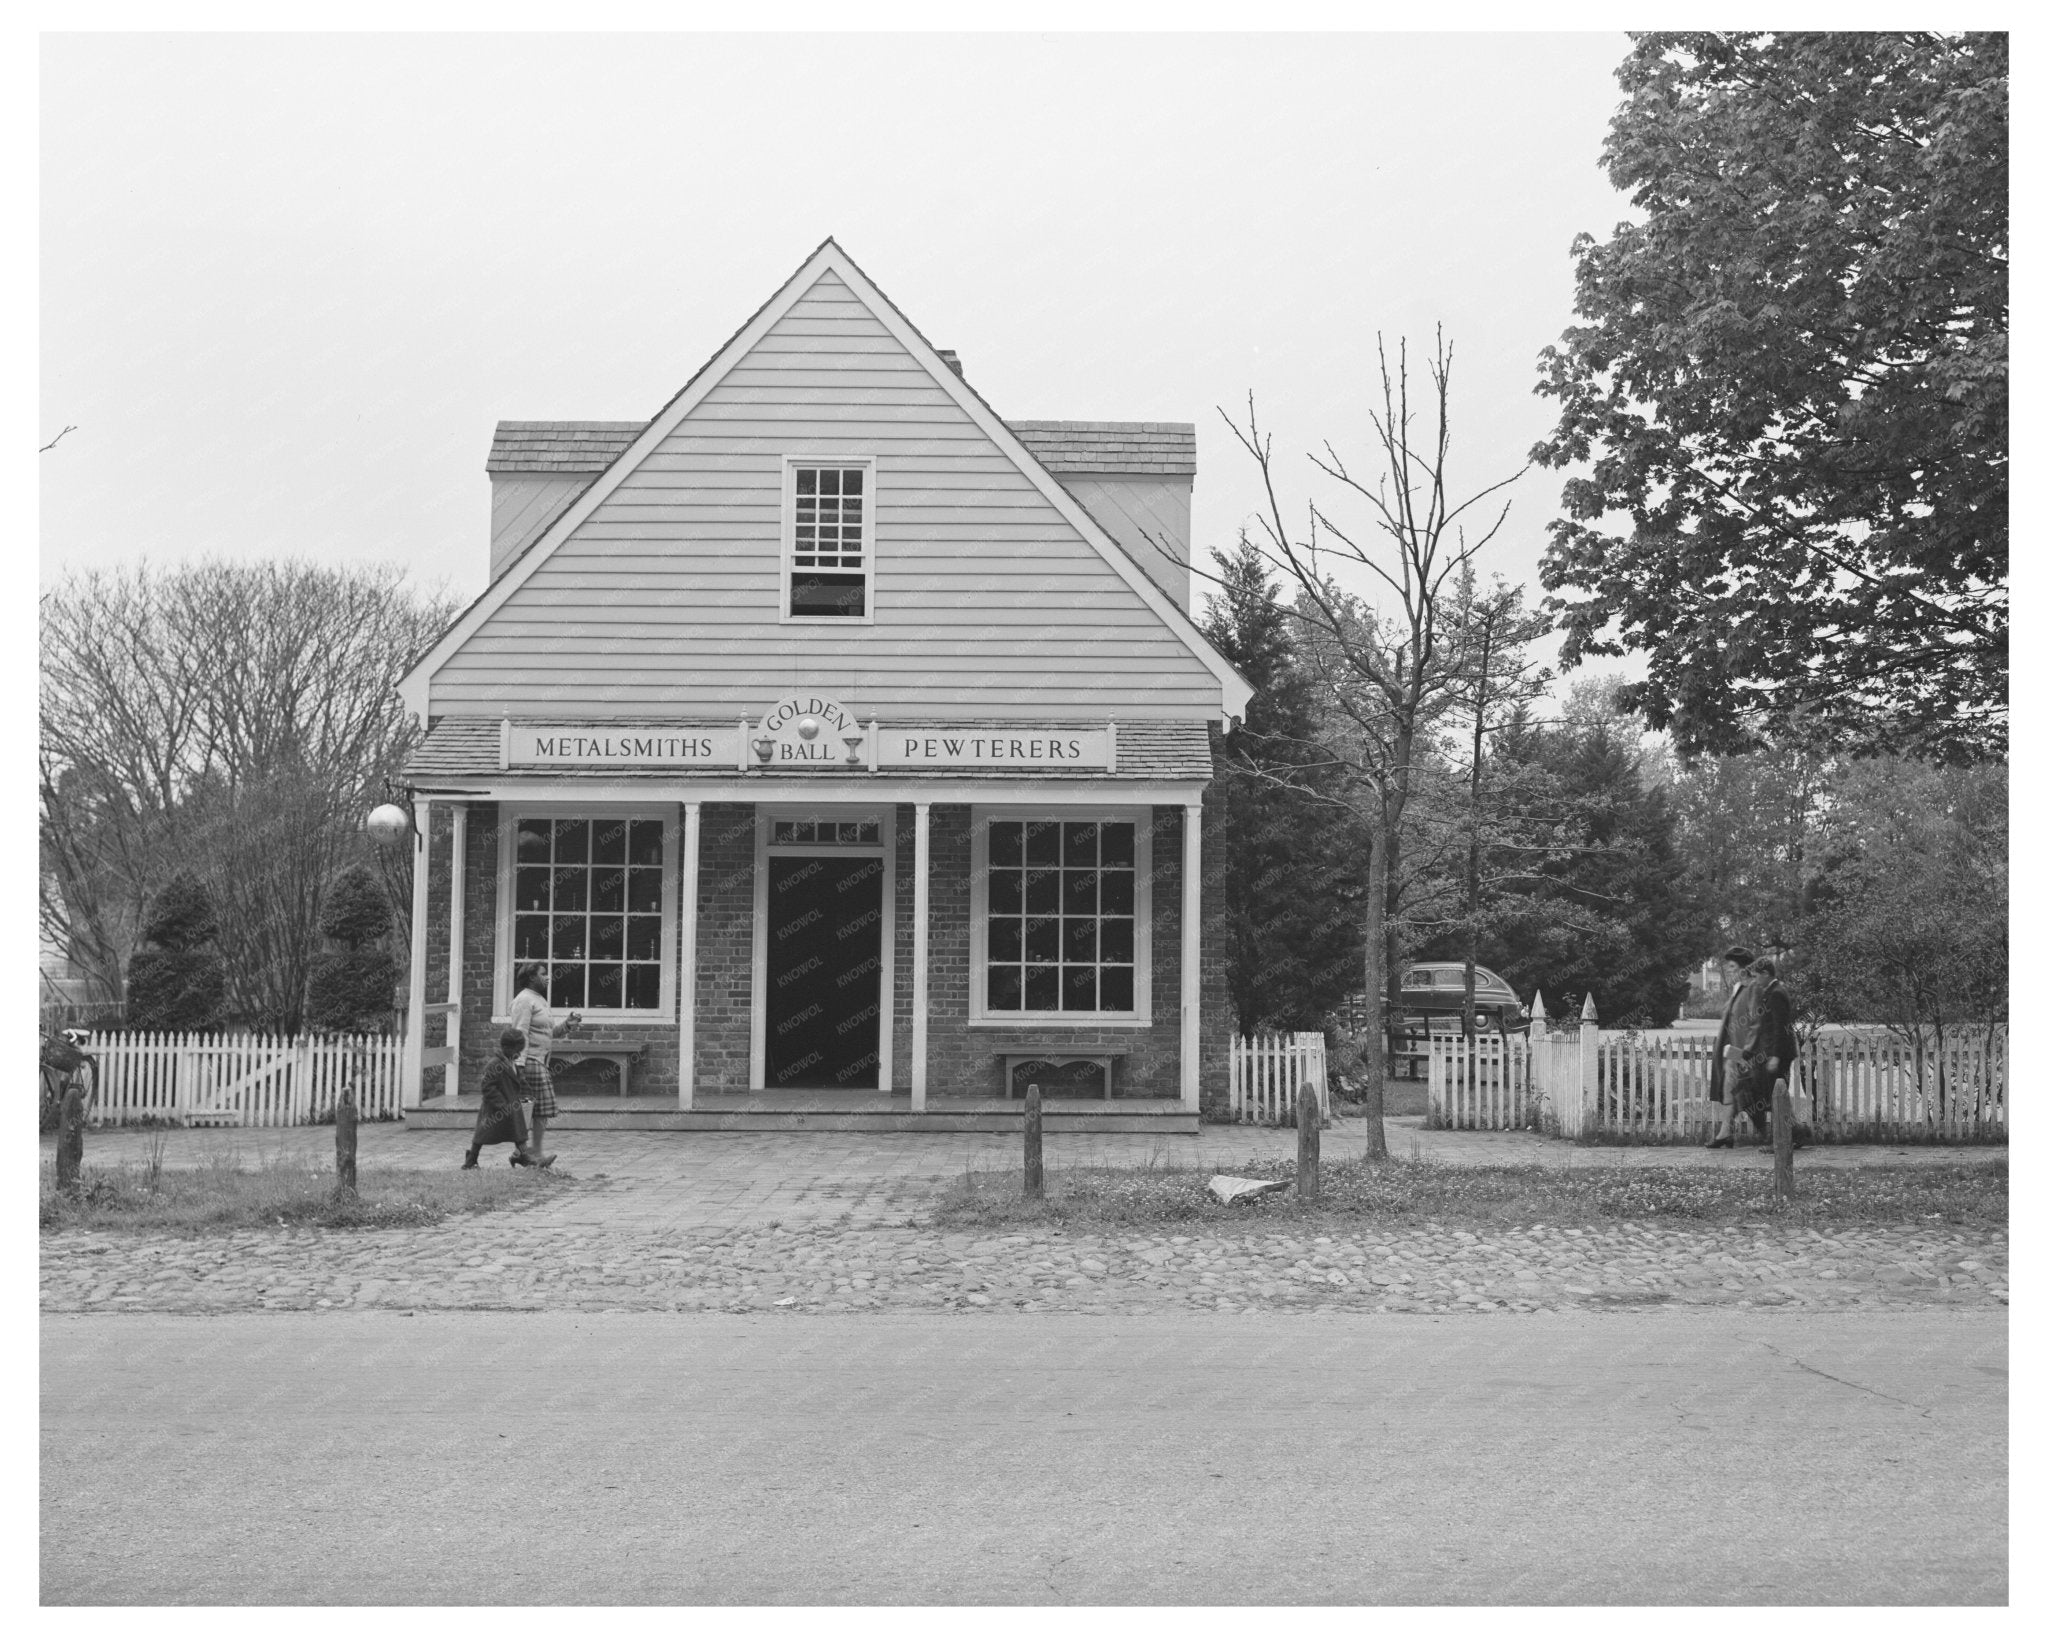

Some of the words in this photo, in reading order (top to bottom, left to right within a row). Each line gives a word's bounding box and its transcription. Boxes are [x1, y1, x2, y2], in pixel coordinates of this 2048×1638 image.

[767, 698, 851, 732] GOLDEN
[536, 738, 712, 758] METALSMITHS
[781, 743, 835, 760] BALL
[905, 739, 1081, 759] PEWTERERS
